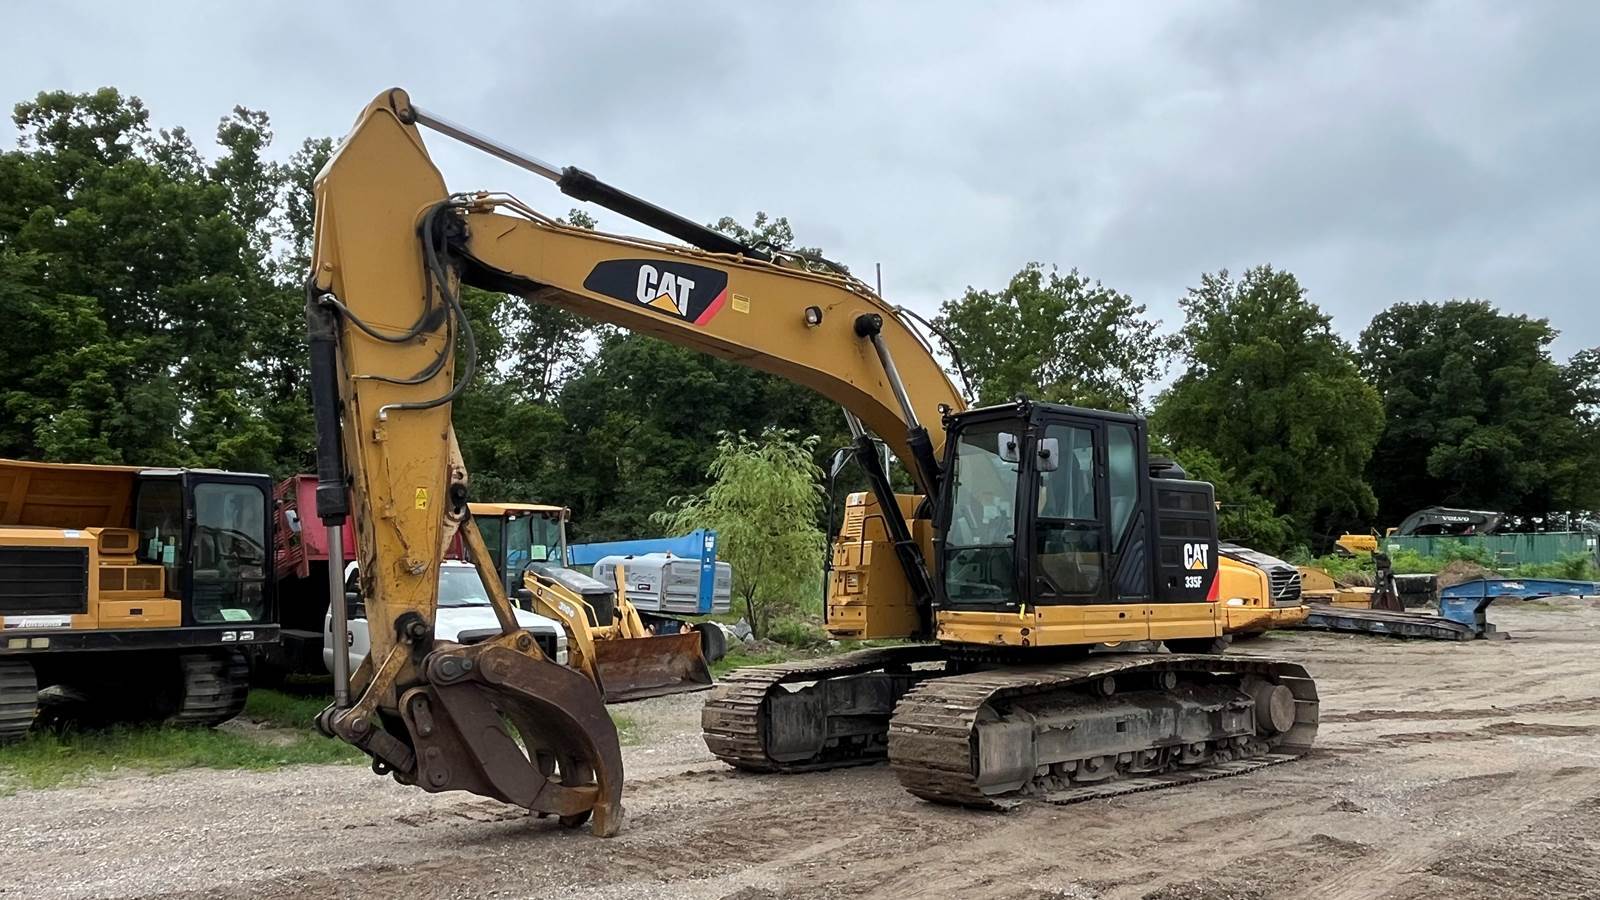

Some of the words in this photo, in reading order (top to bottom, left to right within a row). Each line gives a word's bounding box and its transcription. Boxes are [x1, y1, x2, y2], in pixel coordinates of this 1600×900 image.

[636, 264, 695, 317] CAT
[1183, 543, 1209, 570] CAT
[1185, 576, 1202, 588] 335F
